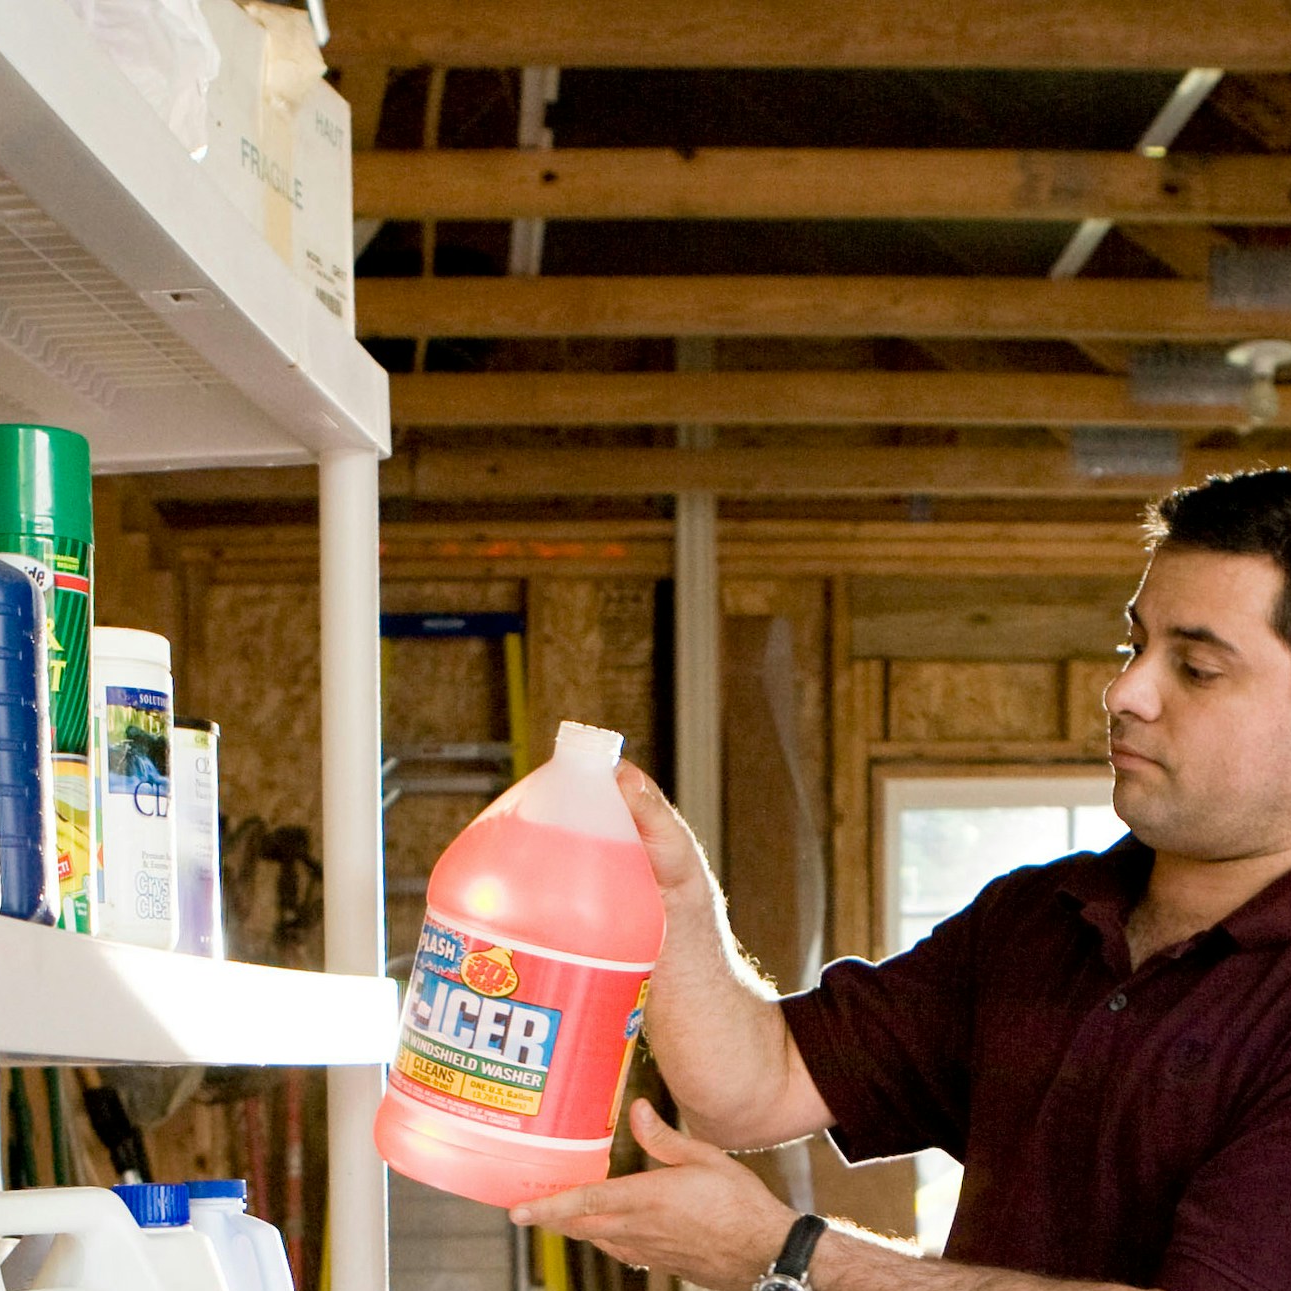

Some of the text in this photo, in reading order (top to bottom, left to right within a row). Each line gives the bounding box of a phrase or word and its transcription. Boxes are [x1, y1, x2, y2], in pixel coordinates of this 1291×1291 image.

[241, 136, 304, 210] FRAGILE
[409, 1031, 543, 1088] WINDSHIELD WASHER
[413, 1057, 455, 1084] CLEANS
[470, 1080, 534, 1103] ONE U.S. Gallon
[500, 1096, 528, 1110] Liters)
